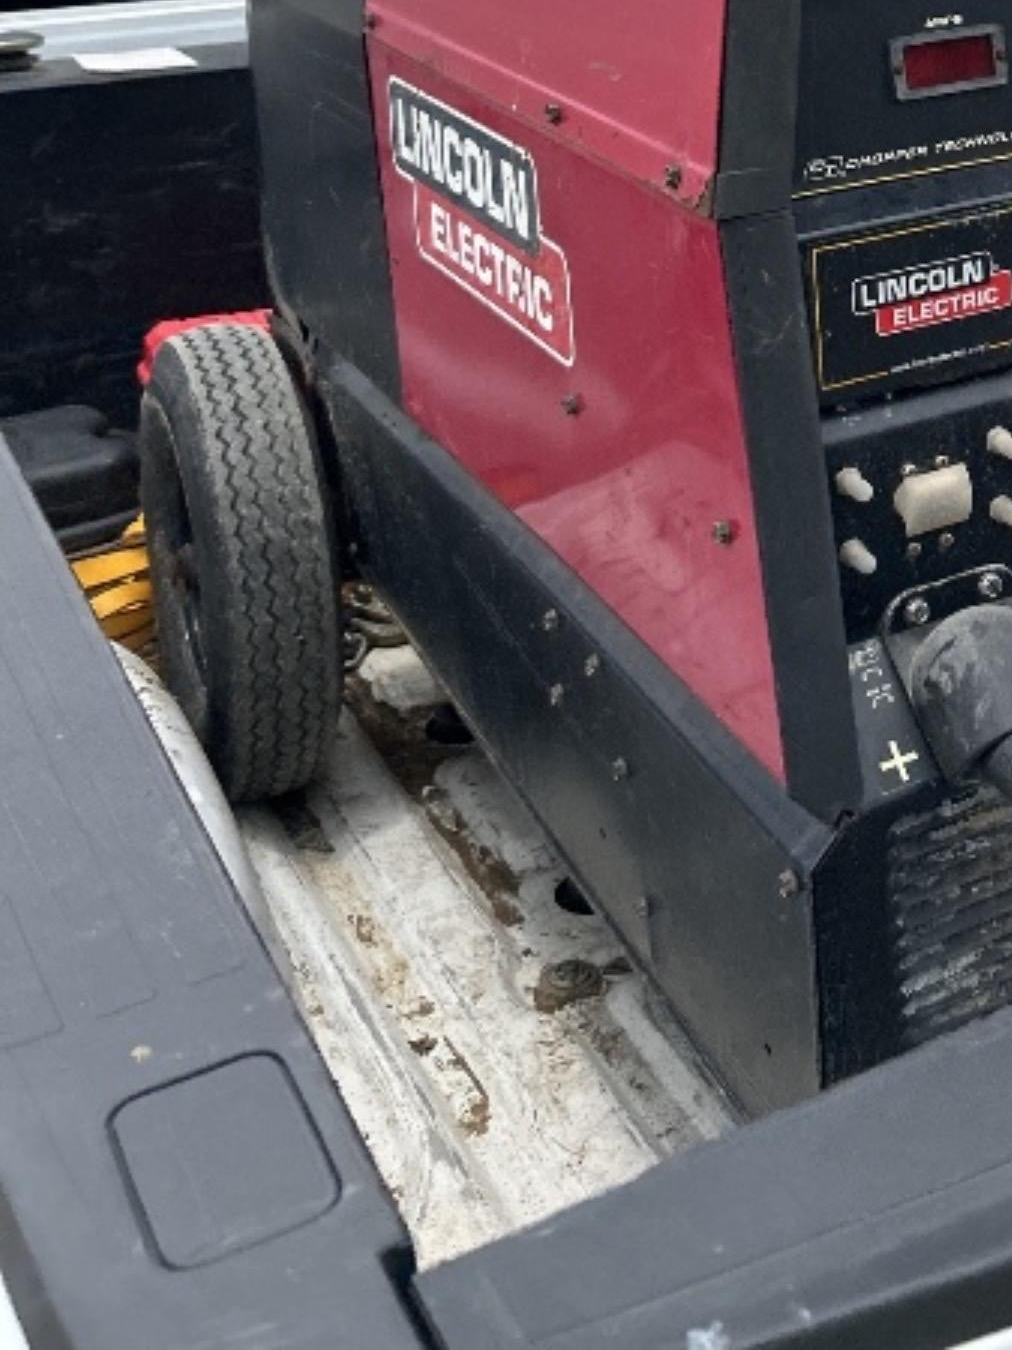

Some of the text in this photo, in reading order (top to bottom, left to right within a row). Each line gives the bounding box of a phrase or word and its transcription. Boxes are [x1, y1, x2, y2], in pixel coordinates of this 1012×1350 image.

[397, 99, 531, 240] LINCOLN
[430, 202, 554, 332] ELECTRIC
[861, 260, 982, 307] LINCOLN
[893, 287, 999, 326] ELECTRIC
